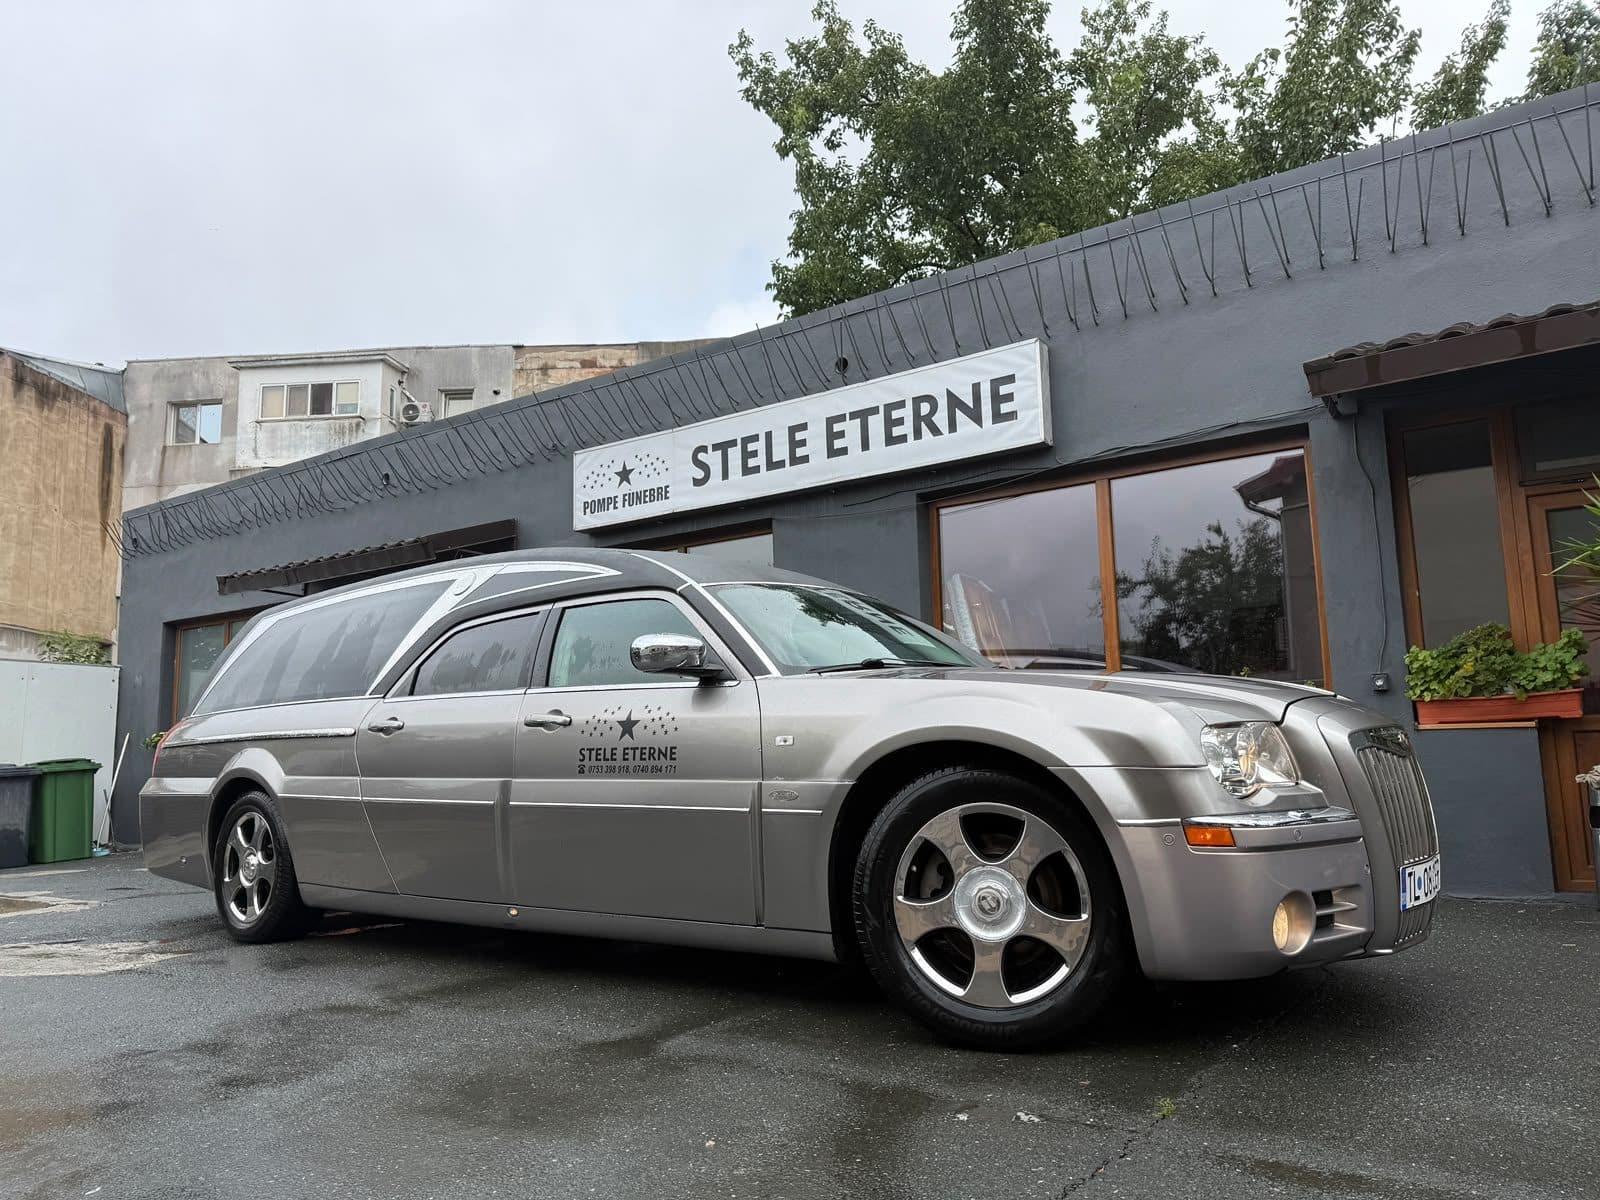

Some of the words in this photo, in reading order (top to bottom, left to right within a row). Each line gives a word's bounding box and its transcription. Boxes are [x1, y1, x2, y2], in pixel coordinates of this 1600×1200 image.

[691, 421, 810, 488] STELE
[825, 373, 1018, 460] ETERNE
[583, 496, 619, 516] POMPE
[578, 747, 618, 763] STELE
[622, 746, 678, 762] ETERNE
[588, 765, 604, 775] 0753
[604, 765, 617, 775] 398
[632, 764, 649, 775] 0740
[664, 764, 677, 775] 171
[1407, 870, 1421, 903] TL
